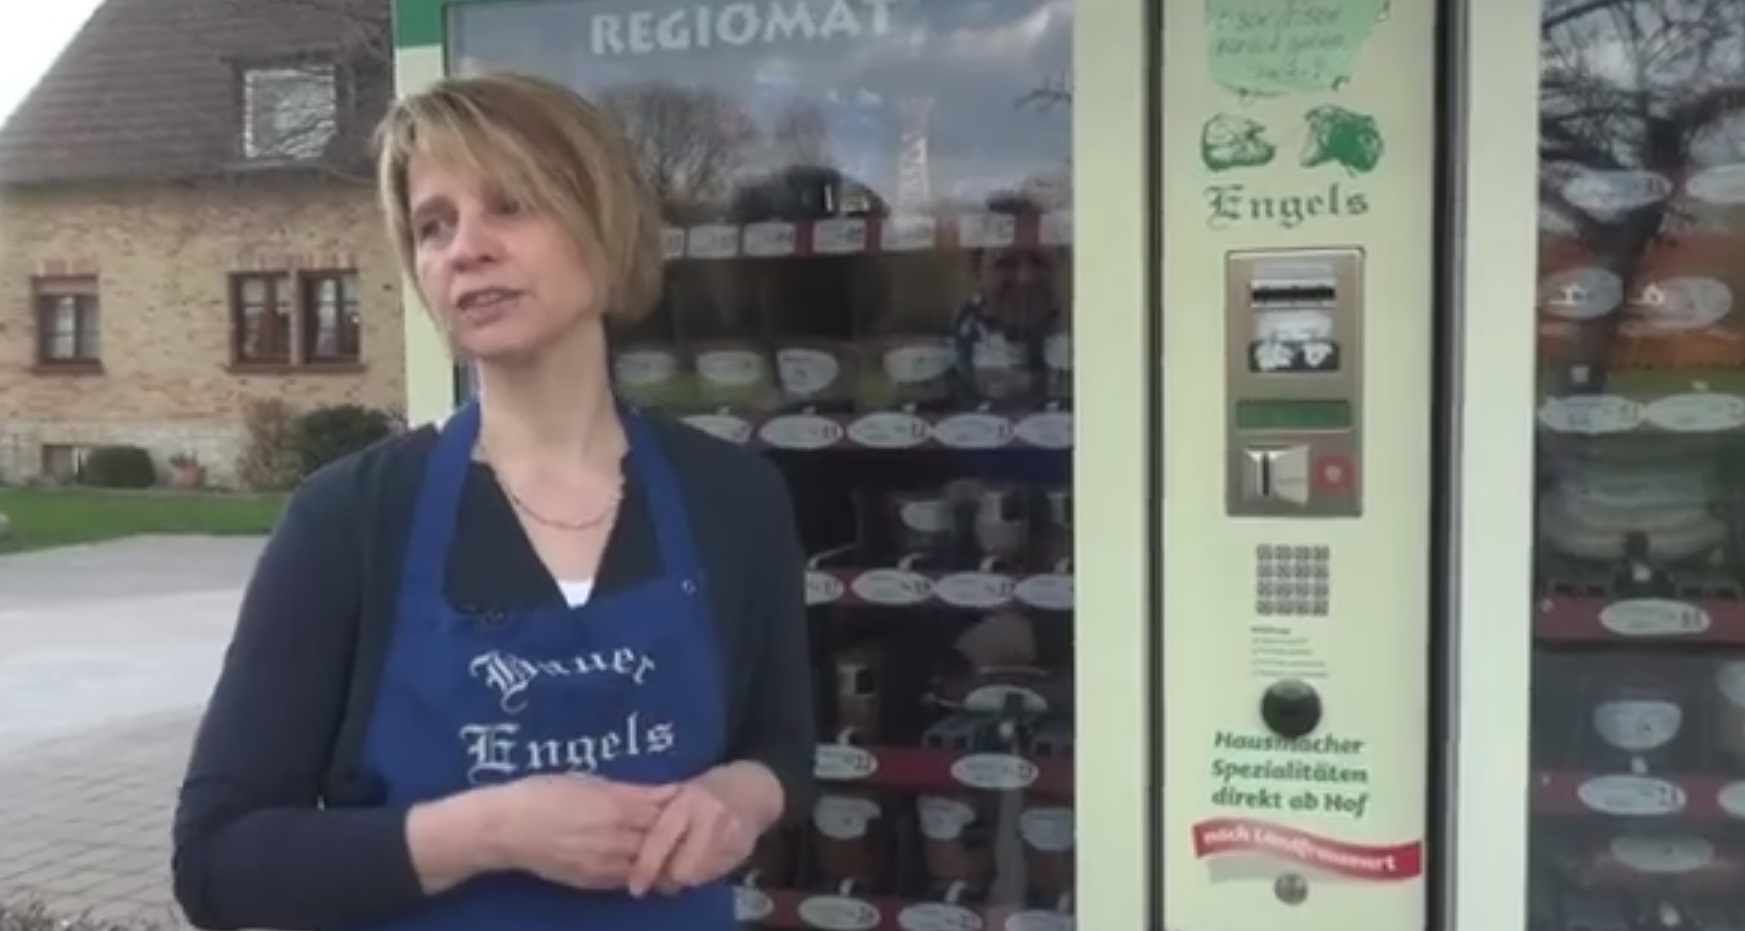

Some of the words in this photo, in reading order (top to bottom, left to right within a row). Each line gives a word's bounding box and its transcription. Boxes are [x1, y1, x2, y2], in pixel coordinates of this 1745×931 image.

[590, 0, 897, 55] REGIOMAT
[1203, 182, 1368, 231] Engels
[469, 647, 656, 714] Bauer
[459, 711, 675, 785] Engels
[1214, 731, 1364, 755] Hausmacher
[1211, 759, 1368, 783] Spezialitäten
[1211, 786, 1282, 809] direkt
[1289, 792, 1319, 810] ab
[1324, 792, 1369, 818] Hof
